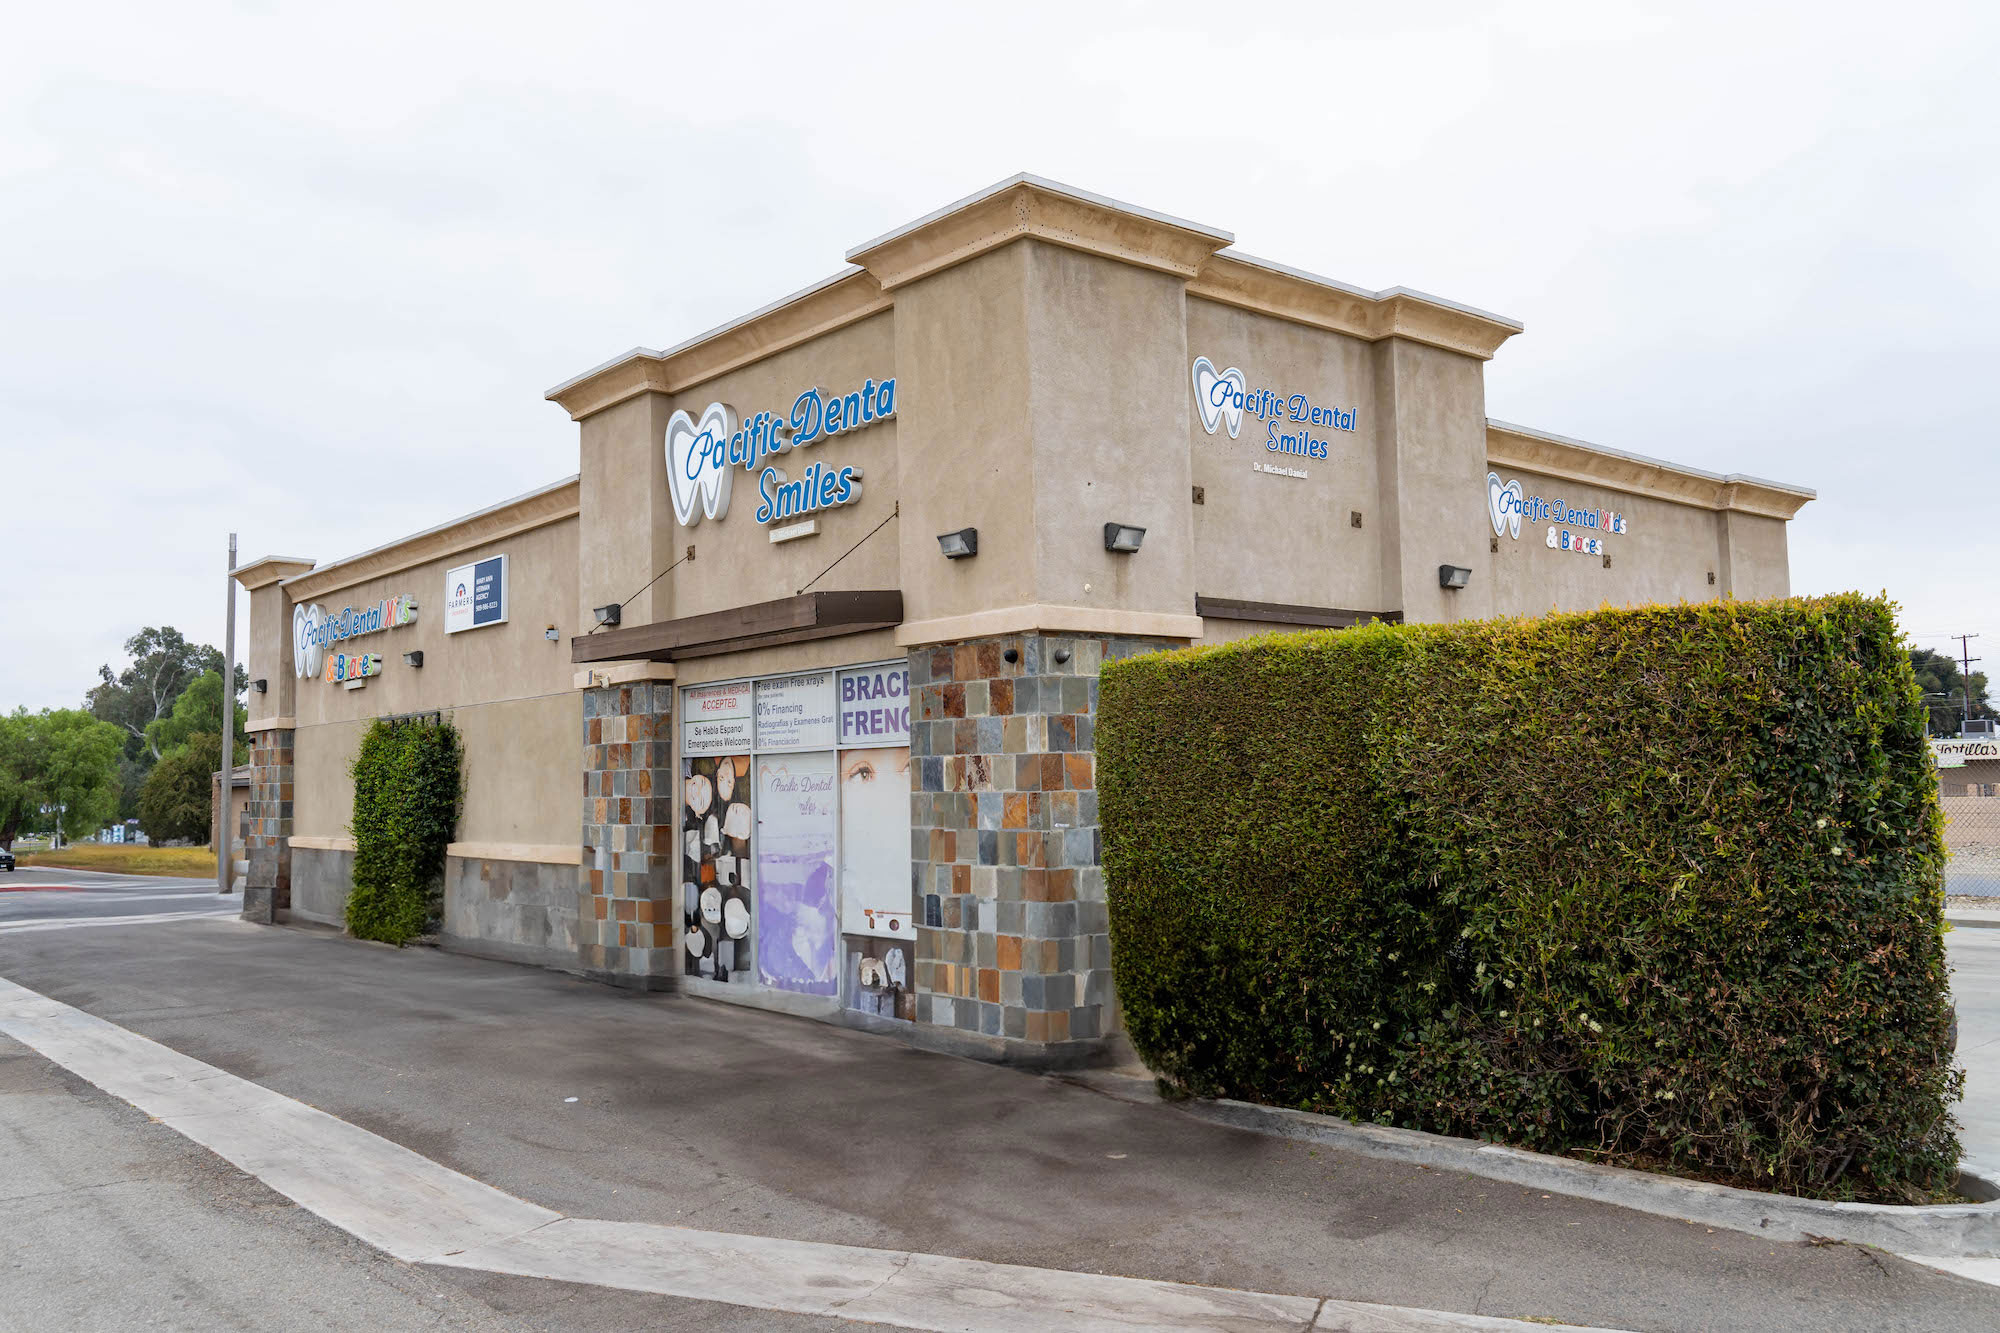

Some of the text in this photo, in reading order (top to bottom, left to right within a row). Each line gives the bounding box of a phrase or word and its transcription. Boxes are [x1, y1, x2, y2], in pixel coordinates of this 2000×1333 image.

[1210, 380, 1357, 432] Pacific Dental
[686, 377, 898, 481] Pacific Denta
[1266, 420, 1328, 459] Smiles
[1253, 462, 1263, 472] Dr.
[1263, 463, 1288, 476] Michael
[755, 461, 854, 524] Smiles
[1498, 490, 1627, 535] Pacific Dental Kids
[1546, 526, 1603, 555] & Braces
[448, 596, 473, 609] FARMERS
[301, 613, 339, 650] Pacific
[340, 600, 383, 640] Dental
[326, 653, 375, 683] & Braces
[757, 676, 824, 691] Free exam Free xrays
[701, 697, 737, 711] ACCEPTED
[757, 702, 803, 716] 0% Financing
[694, 724, 744, 736] Se Habla Espanol
[793, 718, 821, 726] Examenes
[687, 736, 751, 750] Emergencies Welcome
[1936, 743, 1998, 756] Tortillas
[800, 775, 833, 793] Dental
